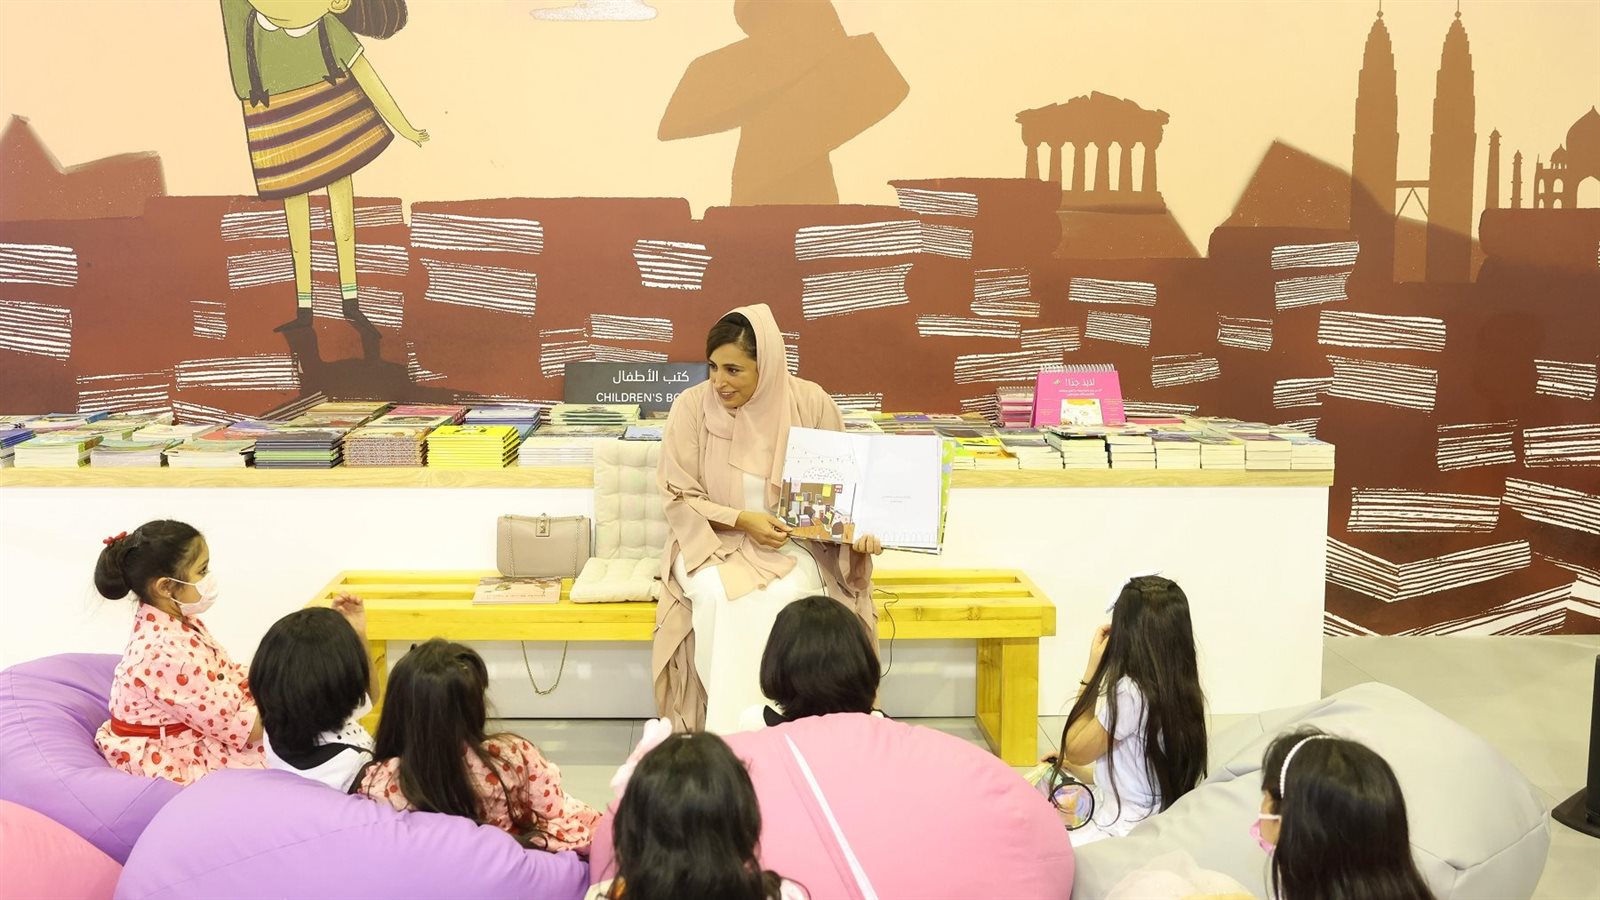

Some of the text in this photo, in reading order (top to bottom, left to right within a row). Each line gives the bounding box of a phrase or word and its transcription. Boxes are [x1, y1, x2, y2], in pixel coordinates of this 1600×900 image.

[612, 368, 689, 384] كتب الأطفال
[596, 392, 663, 403] CHILDREN'S
